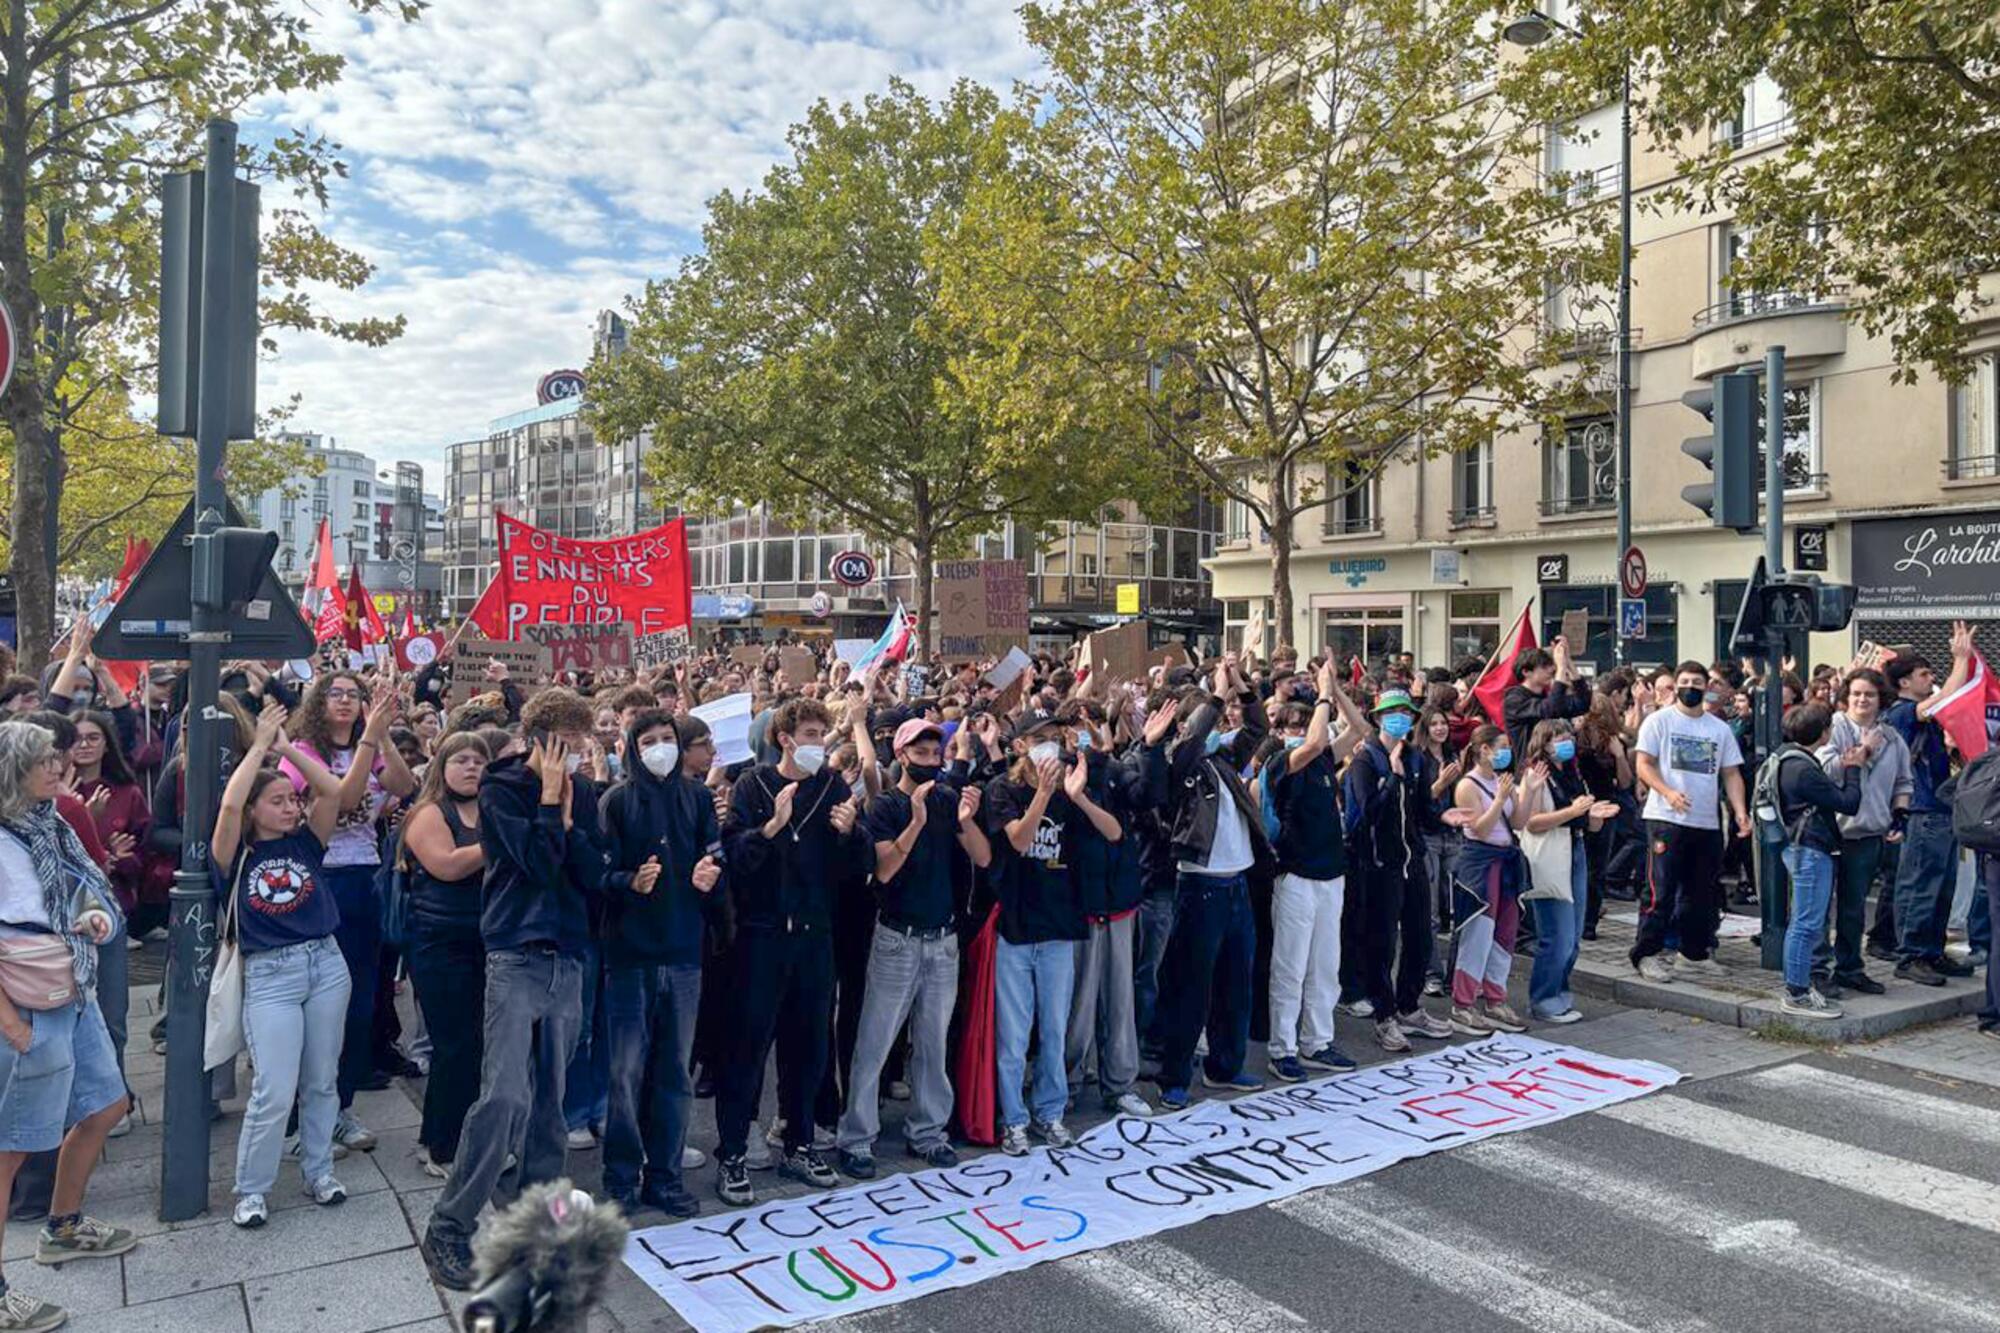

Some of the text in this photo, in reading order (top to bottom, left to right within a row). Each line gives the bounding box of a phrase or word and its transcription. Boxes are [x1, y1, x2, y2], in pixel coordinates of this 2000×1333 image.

[1949, 525, 1964, 536] LA
[502, 522, 672, 564] POLICIERS
[512, 555, 654, 587] ENNEMIS
[842, 559, 867, 578] C&A
[1330, 559, 1386, 574] BLUEBIRD
[573, 585, 609, 606] DU
[1105, 1130, 1368, 1206] CONTRE
